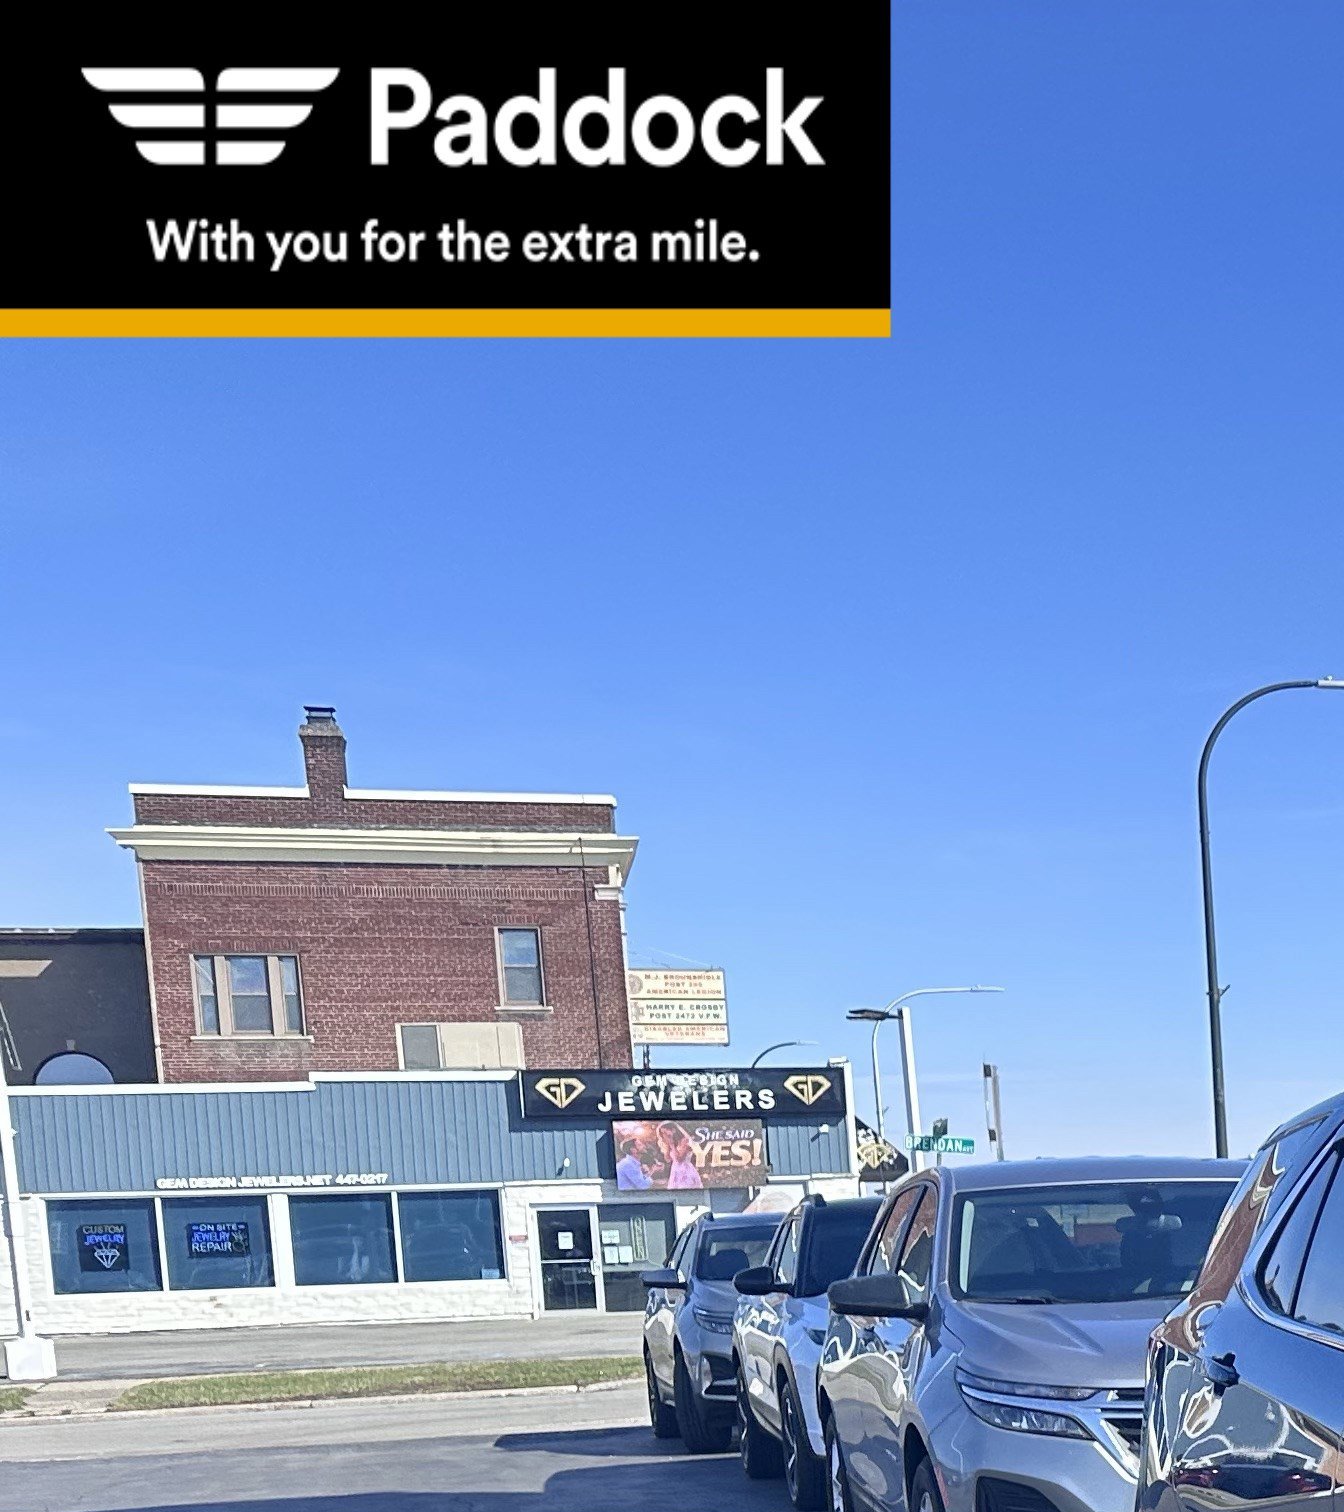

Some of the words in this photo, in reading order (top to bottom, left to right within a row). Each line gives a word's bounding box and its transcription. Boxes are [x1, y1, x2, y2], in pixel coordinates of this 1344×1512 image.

[631, 1074, 668, 1087] GEM
[597, 1088, 776, 1113] JEWELERS
[905, 1135, 963, 1152] BRENDAN
[691, 1138, 762, 1167] YES!
[156, 1177, 189, 1189] GEM
[189, 1176, 237, 1188] DESIGN
[82, 1225, 124, 1234] CUSTOM
[215, 1223, 237, 1232] SITE
[84, 1234, 125, 1246] JEWELRY
[191, 1242, 232, 1253] REPAIR
